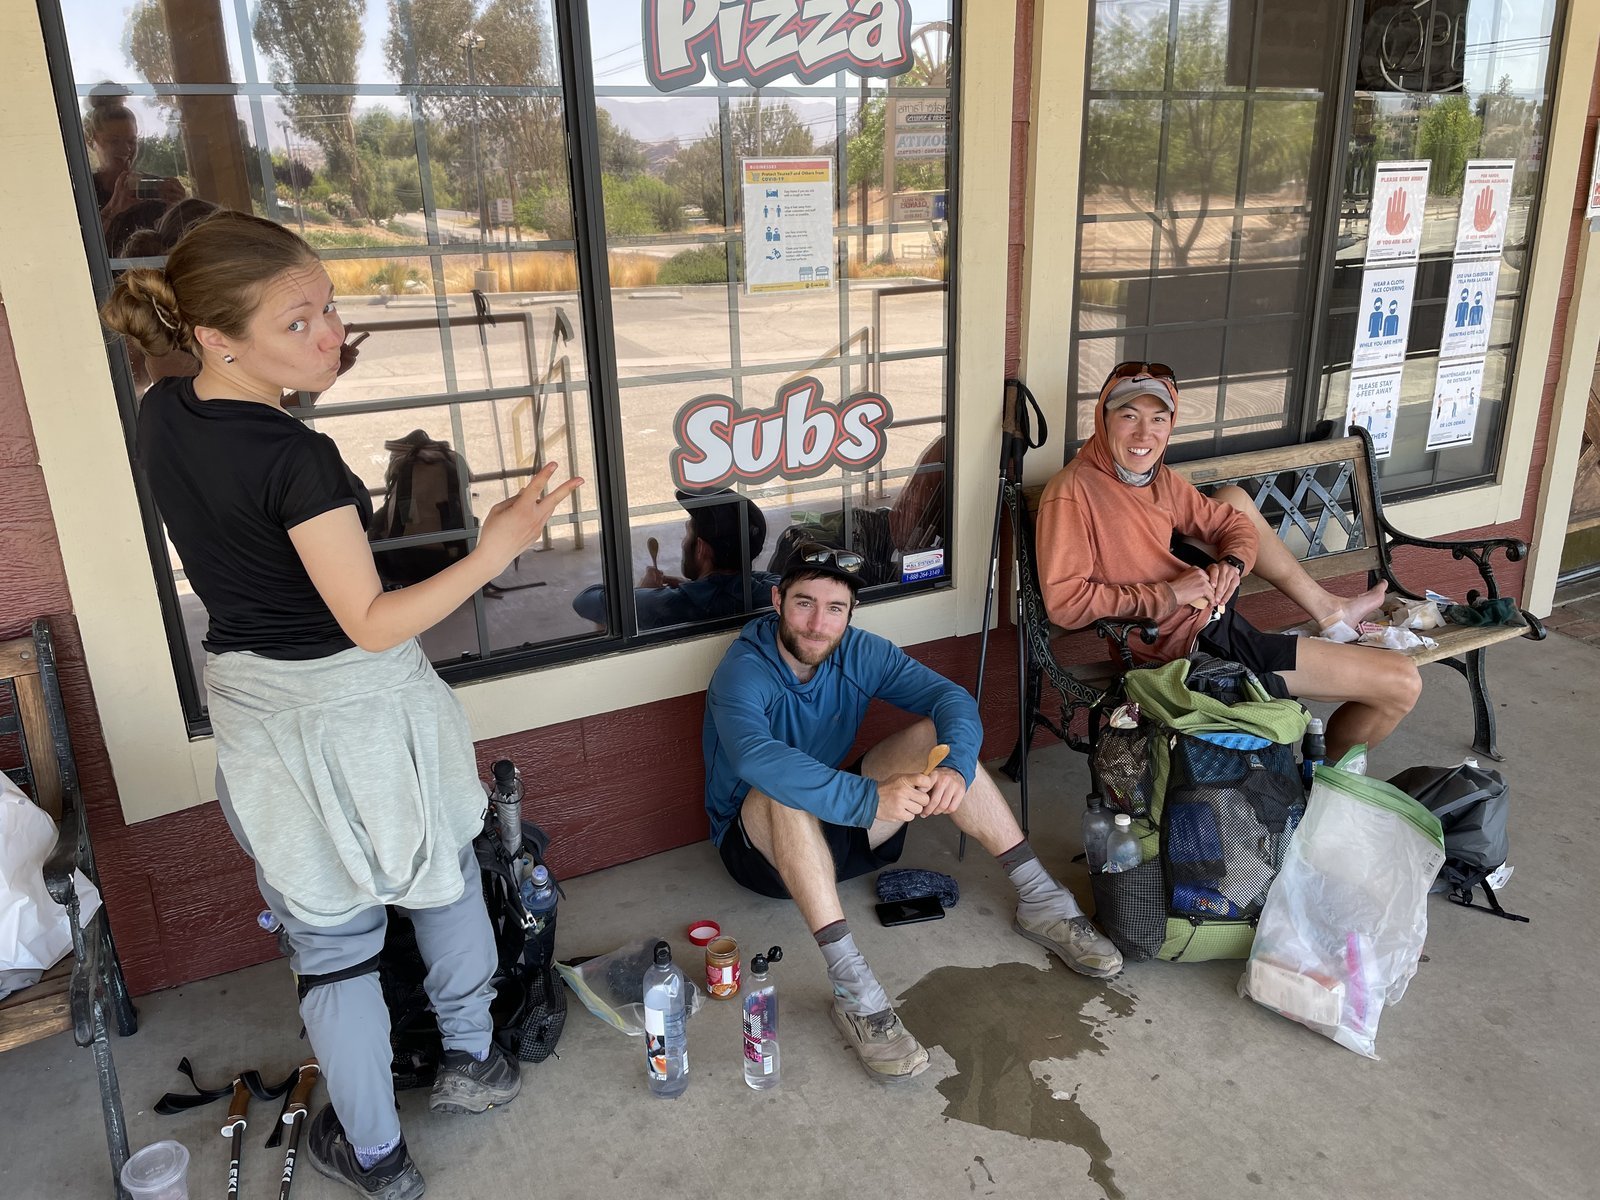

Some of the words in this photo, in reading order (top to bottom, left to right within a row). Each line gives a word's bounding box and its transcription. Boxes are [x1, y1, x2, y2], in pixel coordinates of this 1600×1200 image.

[649, 0, 907, 81] Pizza
[1356, 390, 1375, 398] 6-FEET
[1358, 382, 1378, 390] PLEASE
[677, 382, 888, 488] Subs
[1371, 432, 1388, 440] THERS
[228, 1160, 238, 1192] LEKI
[282, 1149, 295, 1182] LEKI
